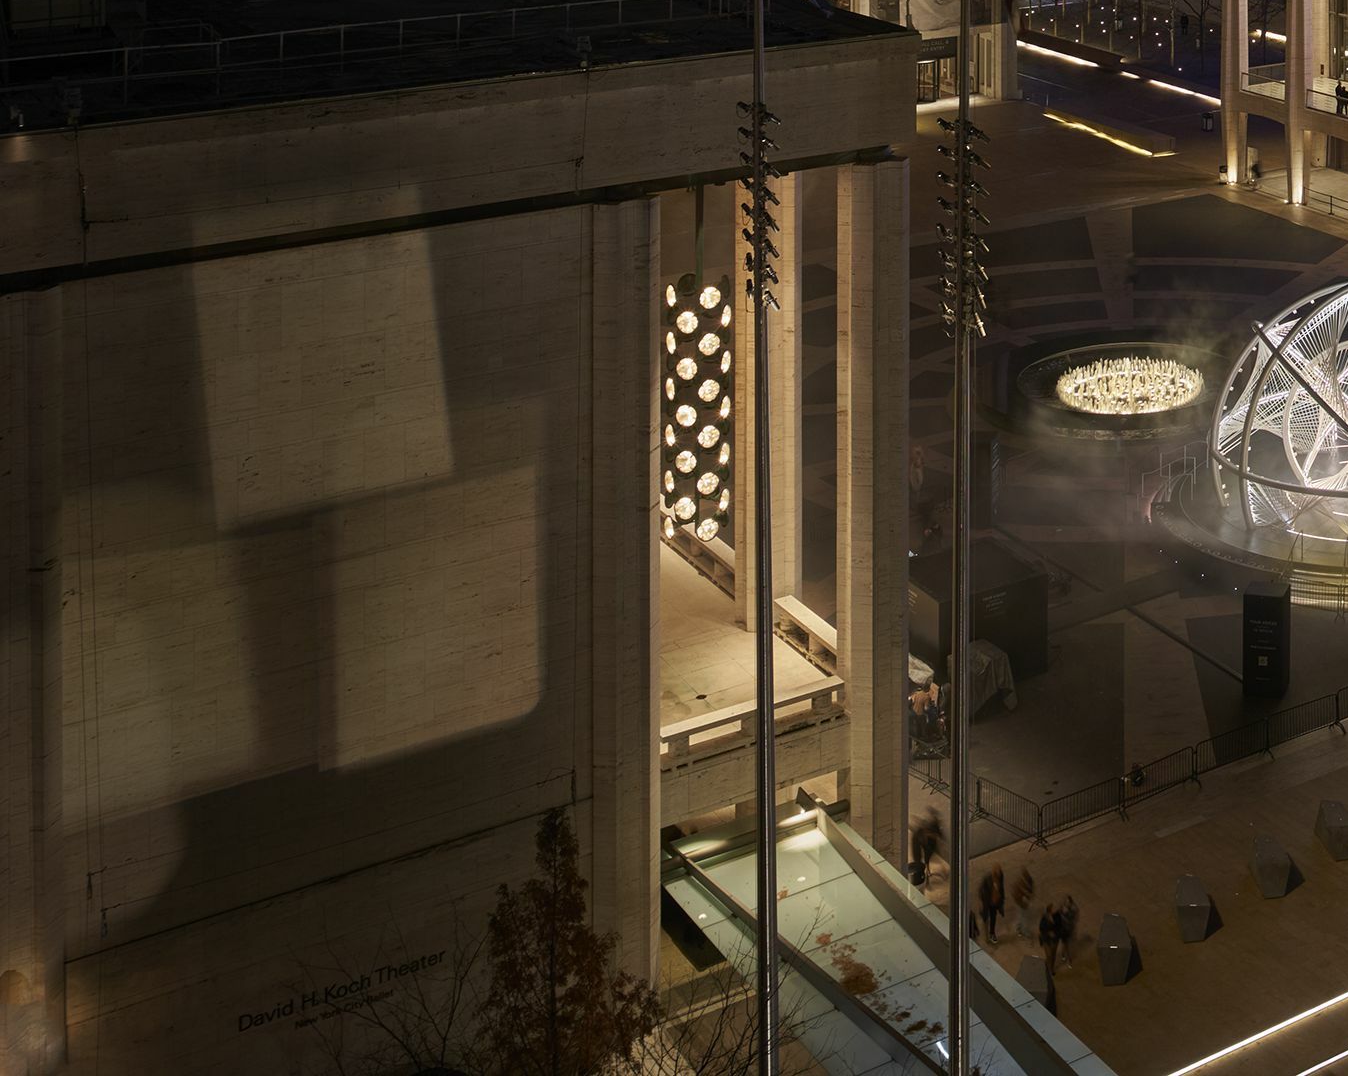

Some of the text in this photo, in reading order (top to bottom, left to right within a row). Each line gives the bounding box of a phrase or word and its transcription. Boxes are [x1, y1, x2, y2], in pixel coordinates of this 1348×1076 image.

[238, 950, 446, 1032] David H. Koch Theater
